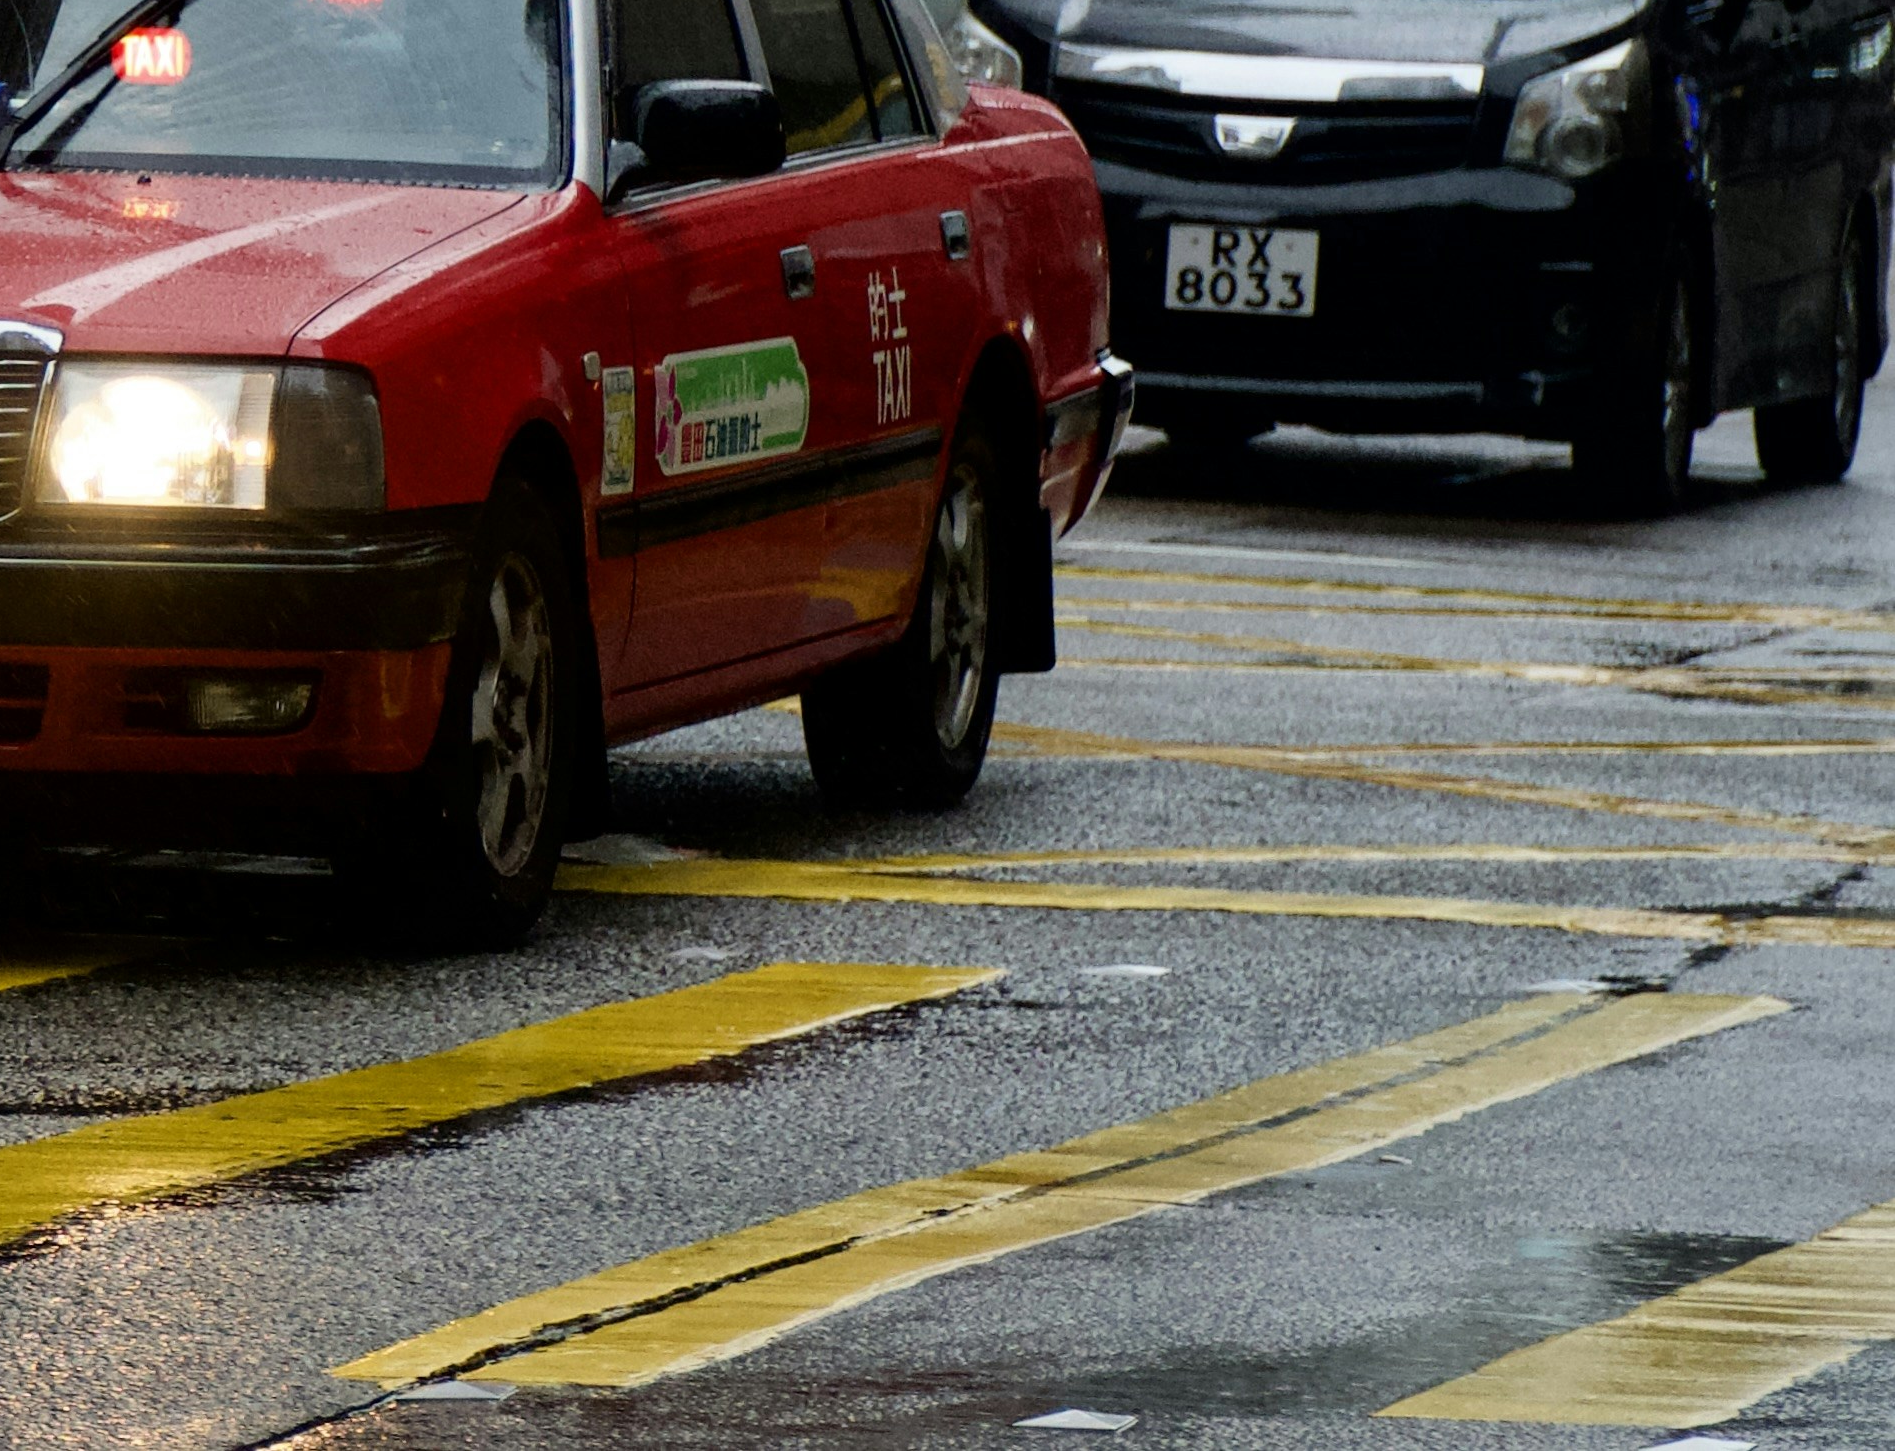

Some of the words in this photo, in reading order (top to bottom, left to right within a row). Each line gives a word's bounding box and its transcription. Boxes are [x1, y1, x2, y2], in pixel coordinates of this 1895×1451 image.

[119, 34, 184, 78] TAXI
[1211, 229, 1274, 268] RX
[867, 265, 908, 343] 的士
[1175, 265, 1305, 310] 8033
[872, 344, 912, 426] TAXI
